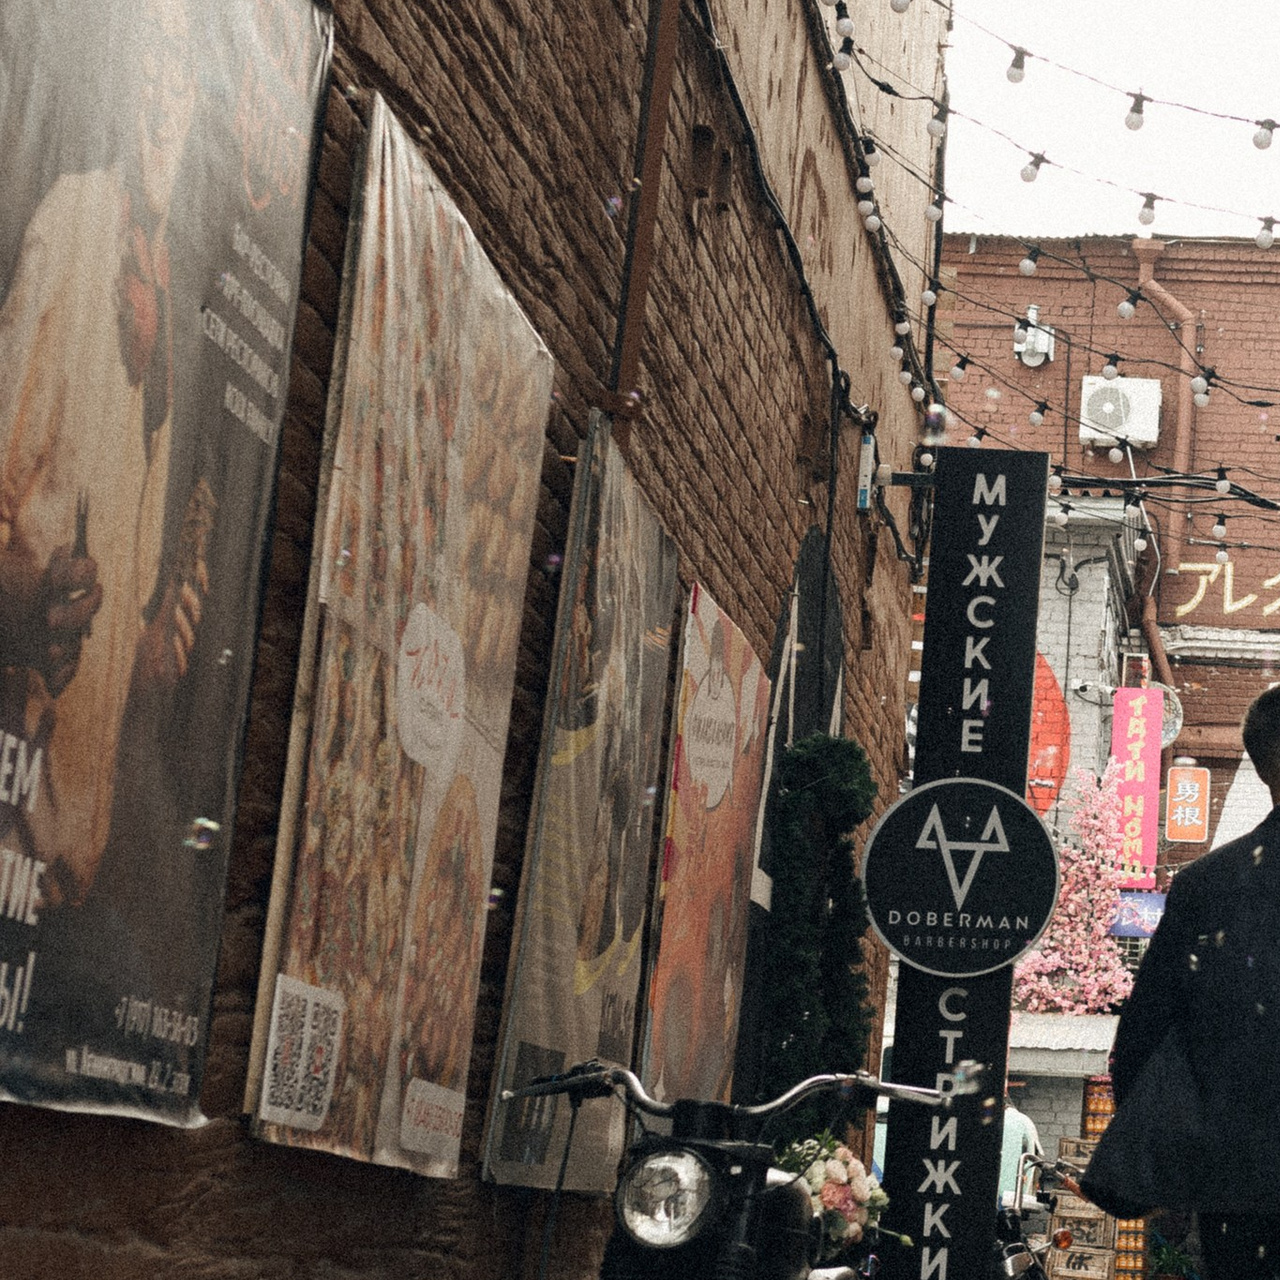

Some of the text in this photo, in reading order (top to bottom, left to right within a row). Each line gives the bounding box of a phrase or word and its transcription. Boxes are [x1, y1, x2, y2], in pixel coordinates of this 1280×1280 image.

[960, 473, 1006, 752] МУЖСКИЕ
[888, 910, 1029, 930] DOBERMAN
[903, 934, 1011, 949] BARBERSHOP
